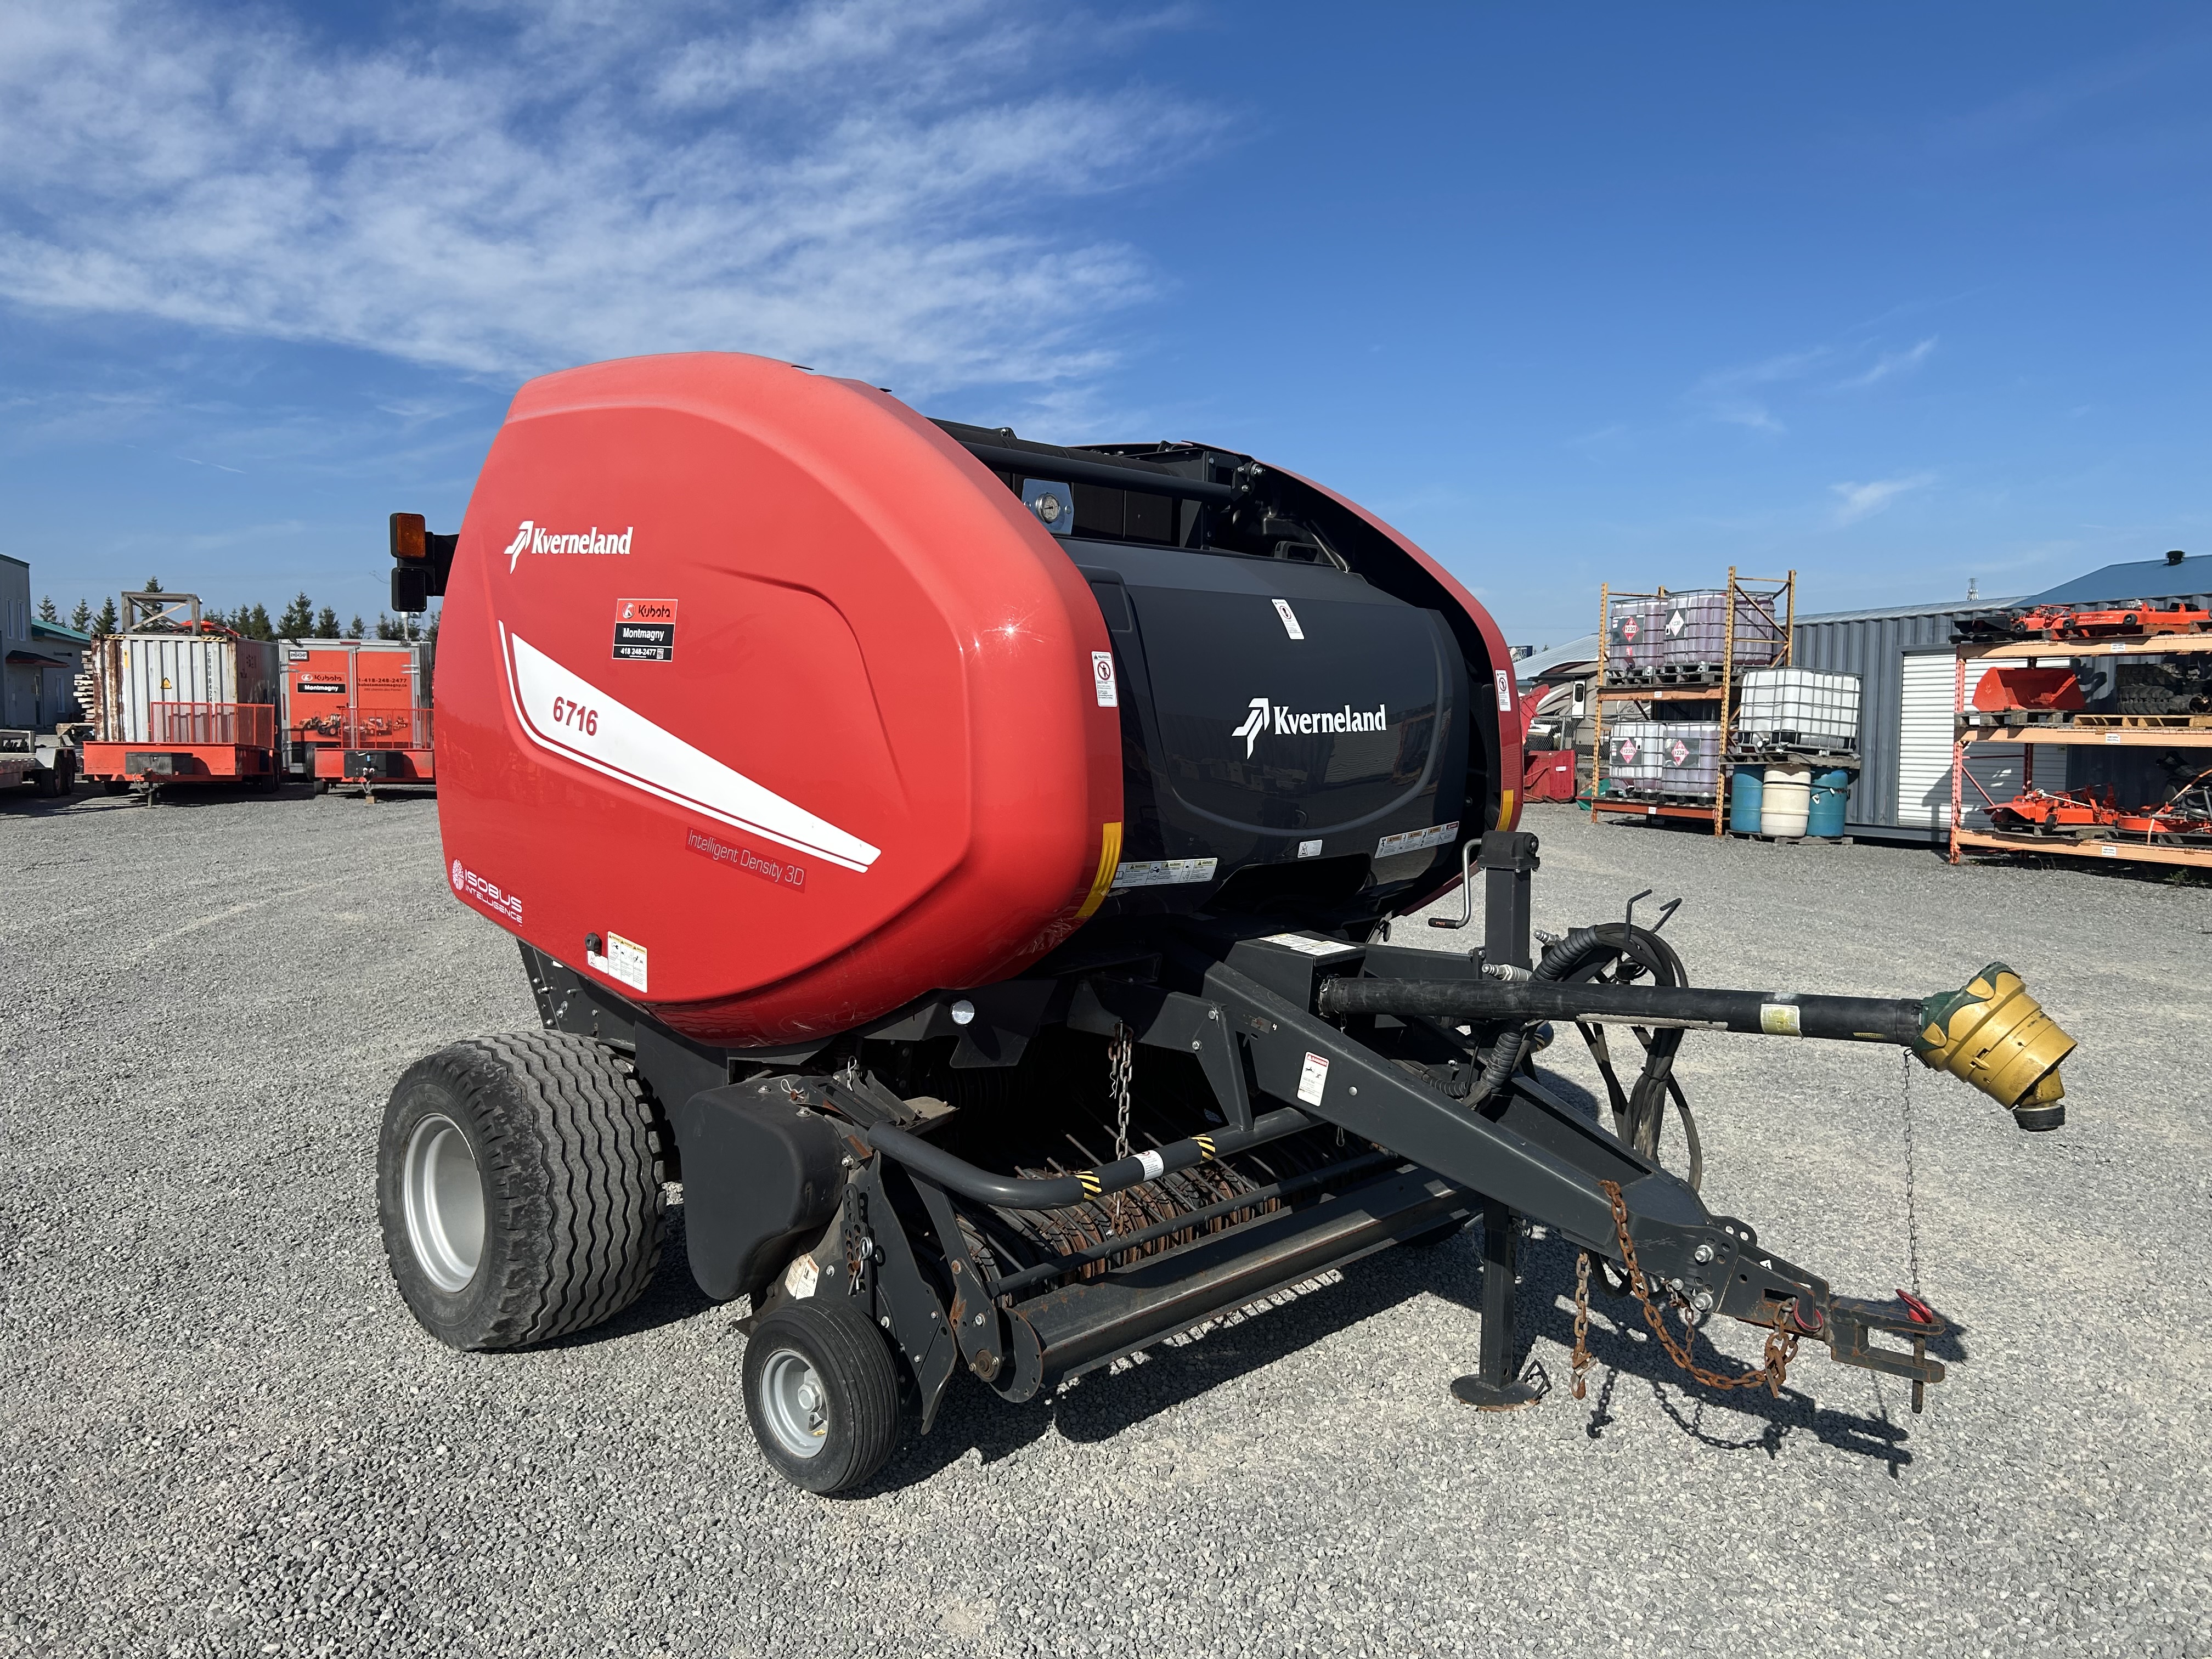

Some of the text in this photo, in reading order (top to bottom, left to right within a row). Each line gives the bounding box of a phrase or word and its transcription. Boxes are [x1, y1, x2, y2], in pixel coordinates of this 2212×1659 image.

[532, 526, 634, 555] Kverneland
[638, 605, 670, 618] Kubota
[623, 628, 665, 641] Montmagny
[304, 684, 339, 692] Montmagny
[553, 696, 599, 736] 6716
[1273, 704, 1387, 735] Kverneland
[688, 829, 804, 886] Intelligent Density 3D
[465, 868, 522, 913] ISOBUS
[465, 884, 523, 924] INTELLIGENCE
